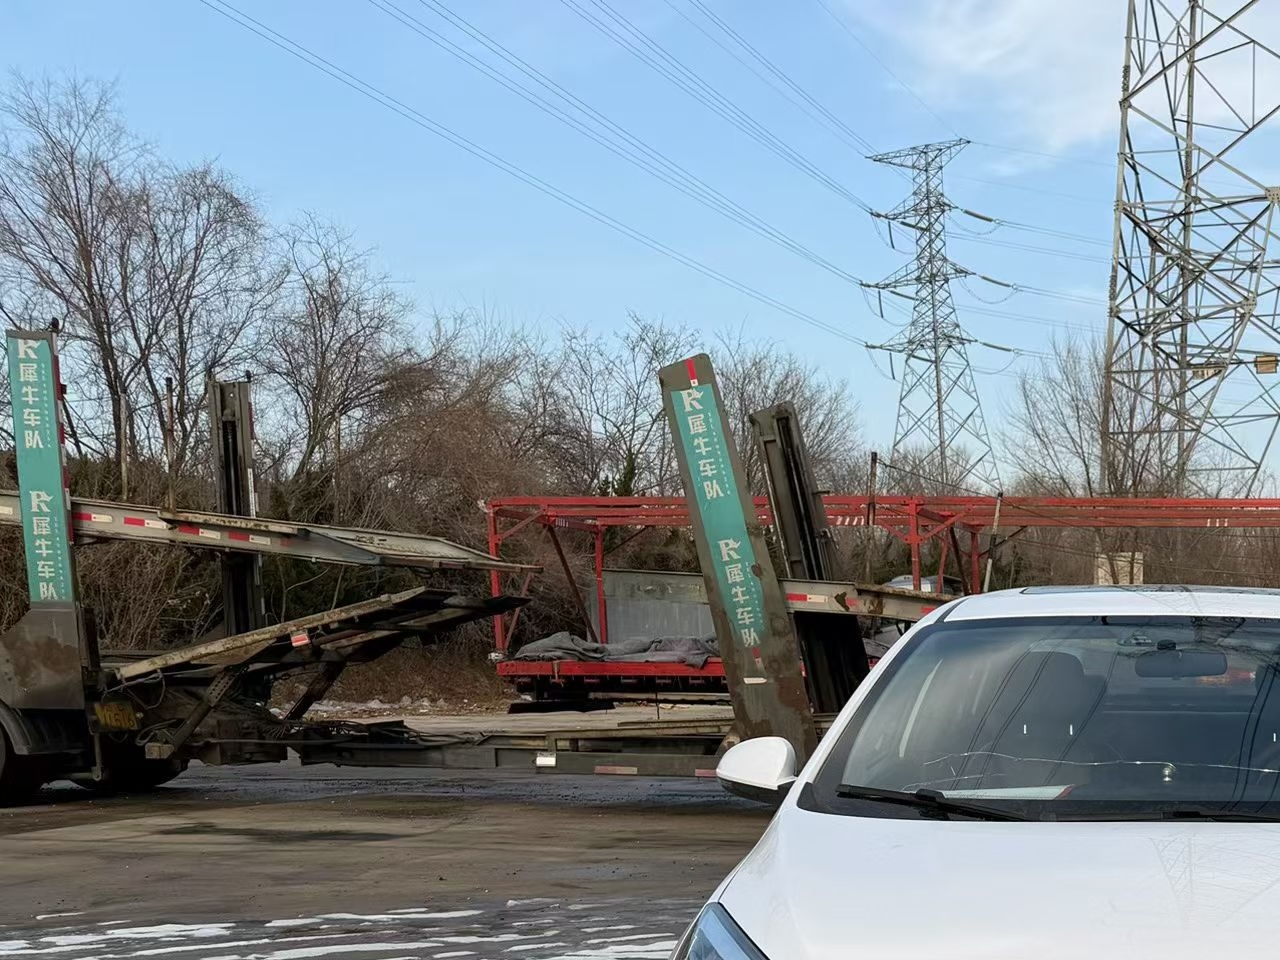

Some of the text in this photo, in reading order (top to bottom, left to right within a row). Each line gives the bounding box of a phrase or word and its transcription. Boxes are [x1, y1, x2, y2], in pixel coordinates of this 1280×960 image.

[19, 364, 44, 449] 犀牛车队
[688, 415, 724, 500] 犀牛车队
[33, 516, 57, 601] 犀牛车队
[726, 563, 761, 648] 犀牛车队
